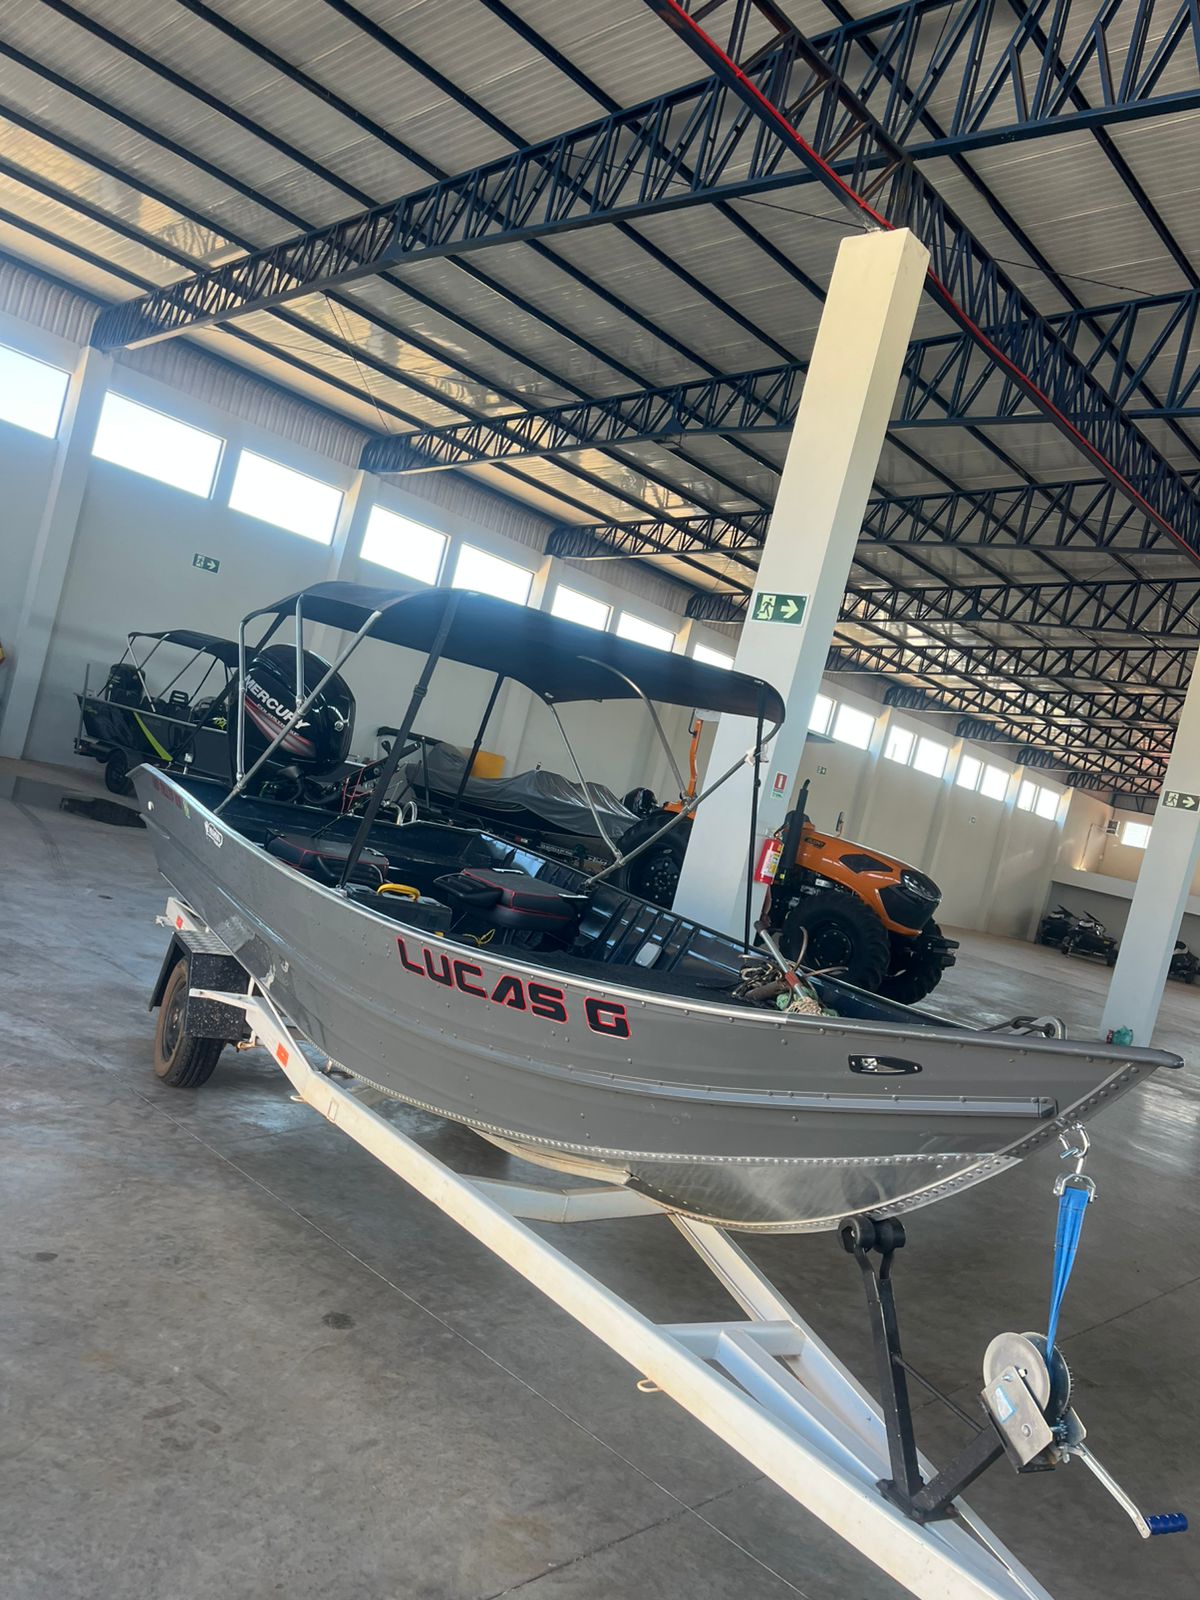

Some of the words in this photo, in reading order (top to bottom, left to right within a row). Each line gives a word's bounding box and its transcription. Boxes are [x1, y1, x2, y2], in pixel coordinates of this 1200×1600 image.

[244, 674, 311, 730] MERCURY
[395, 935, 568, 1024] LUCAS
[584, 997, 631, 1040] G
